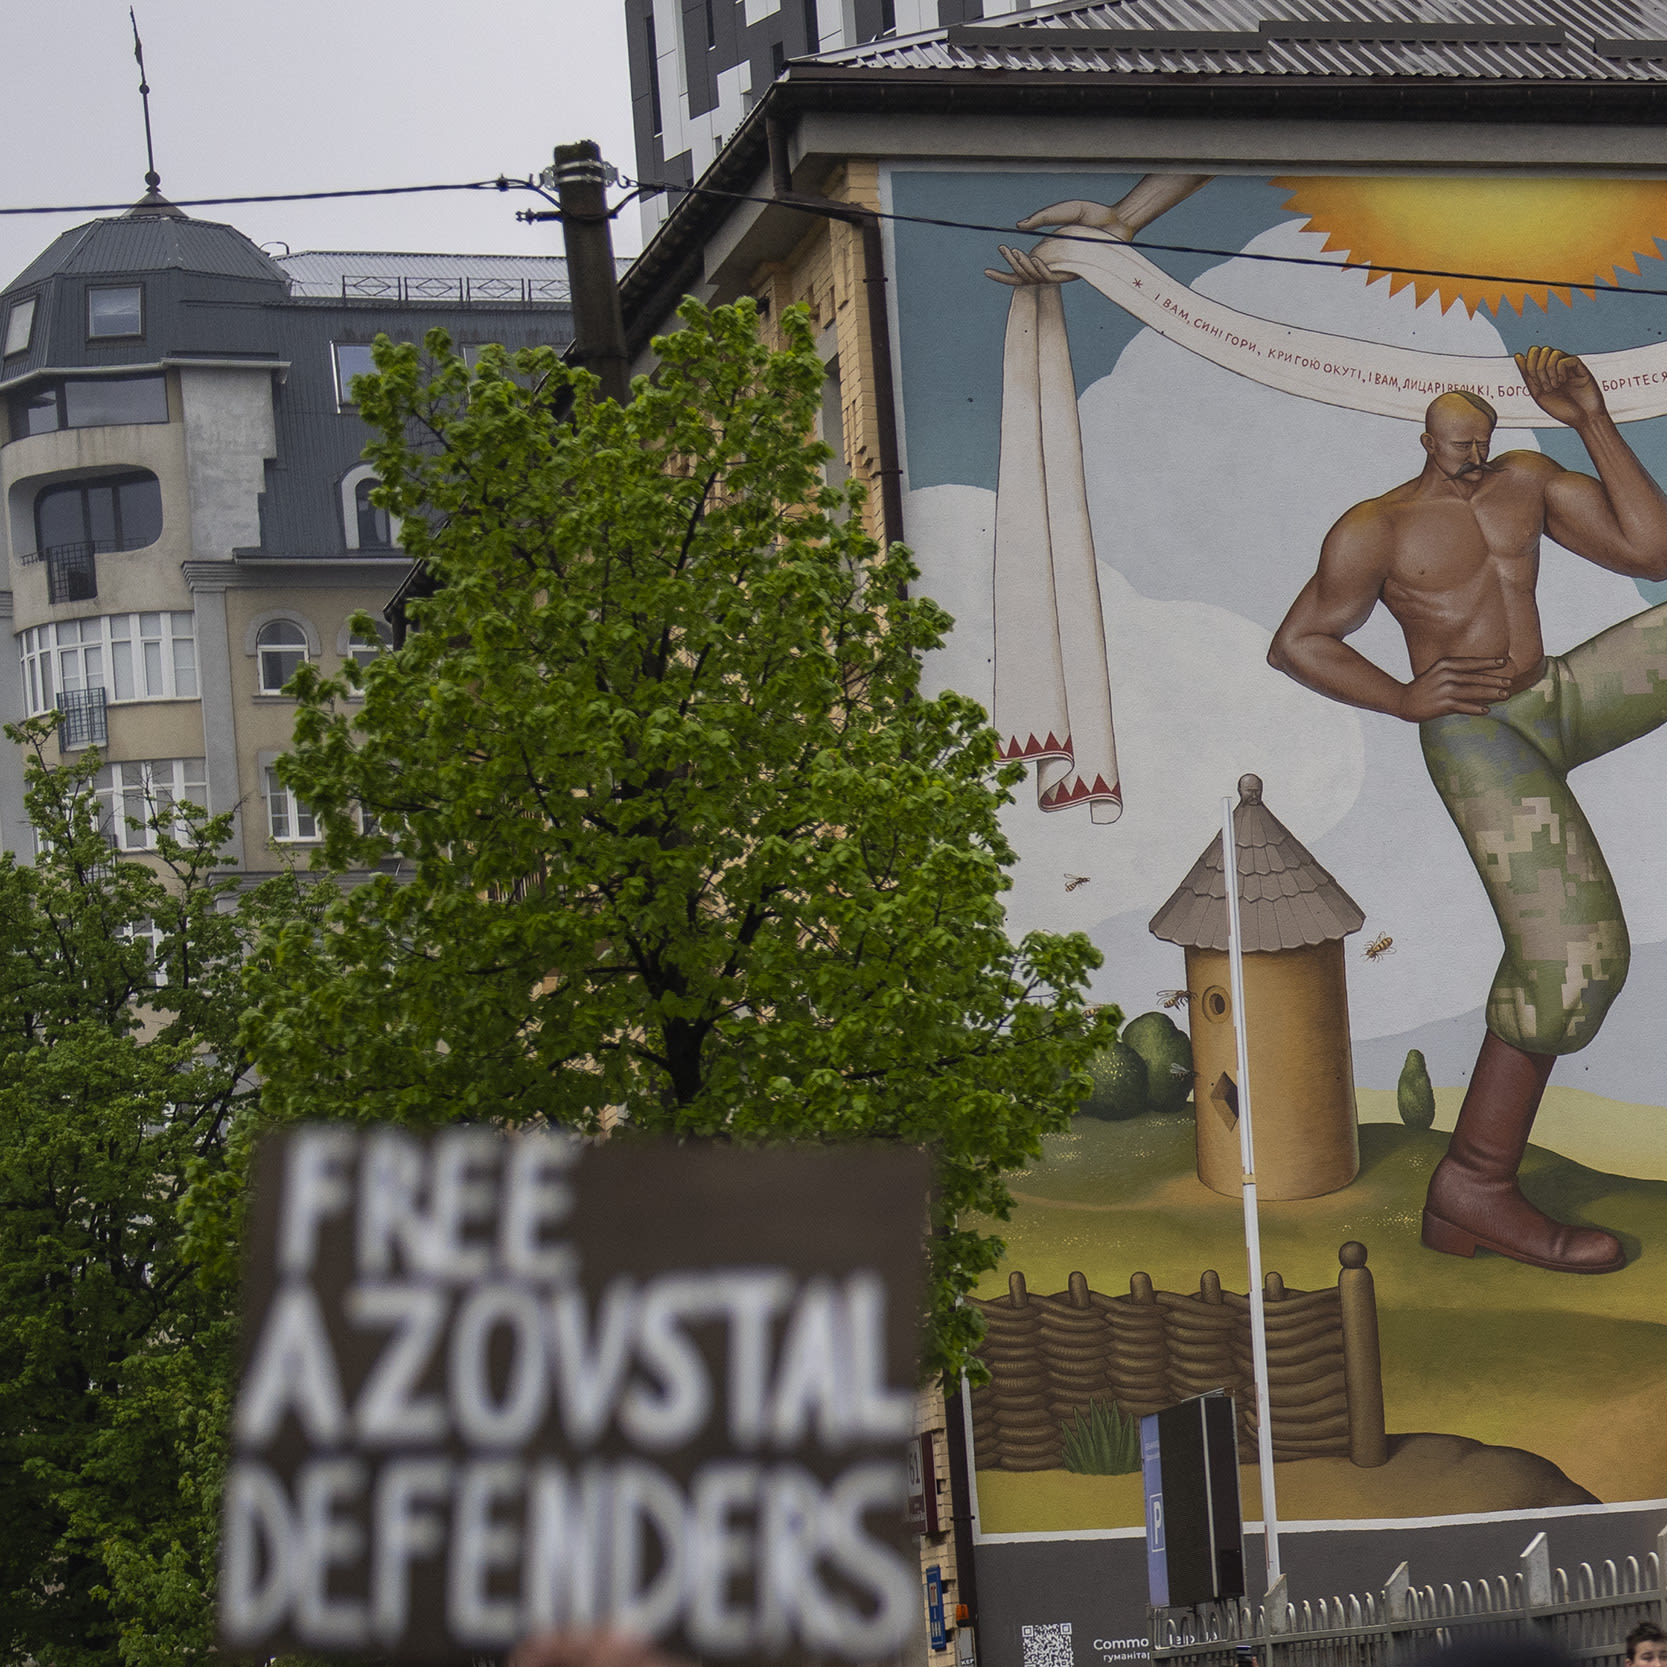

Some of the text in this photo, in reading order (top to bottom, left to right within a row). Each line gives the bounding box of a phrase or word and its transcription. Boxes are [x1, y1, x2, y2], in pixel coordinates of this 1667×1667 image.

[1162, 298, 1191, 325] ВАМ,
[1193, 318, 1224, 339] СИНІ
[1225, 332, 1262, 357] ГОРИ,
[1267, 348, 1321, 370] КРИГОЮ
[1374, 373, 1401, 393] ВАМ,
[1402, 378, 1445, 395] ЛИЦАРІ
[1497, 385, 1531, 398] БОГО
[275, 1122, 580, 1282] FREE
[238, 1268, 918, 1450] AZOVSTAL
[216, 1455, 922, 1660] DEFENDERS
[1153, 1501, 1162, 1544] P
[1093, 1638, 1150, 1651] Commo
